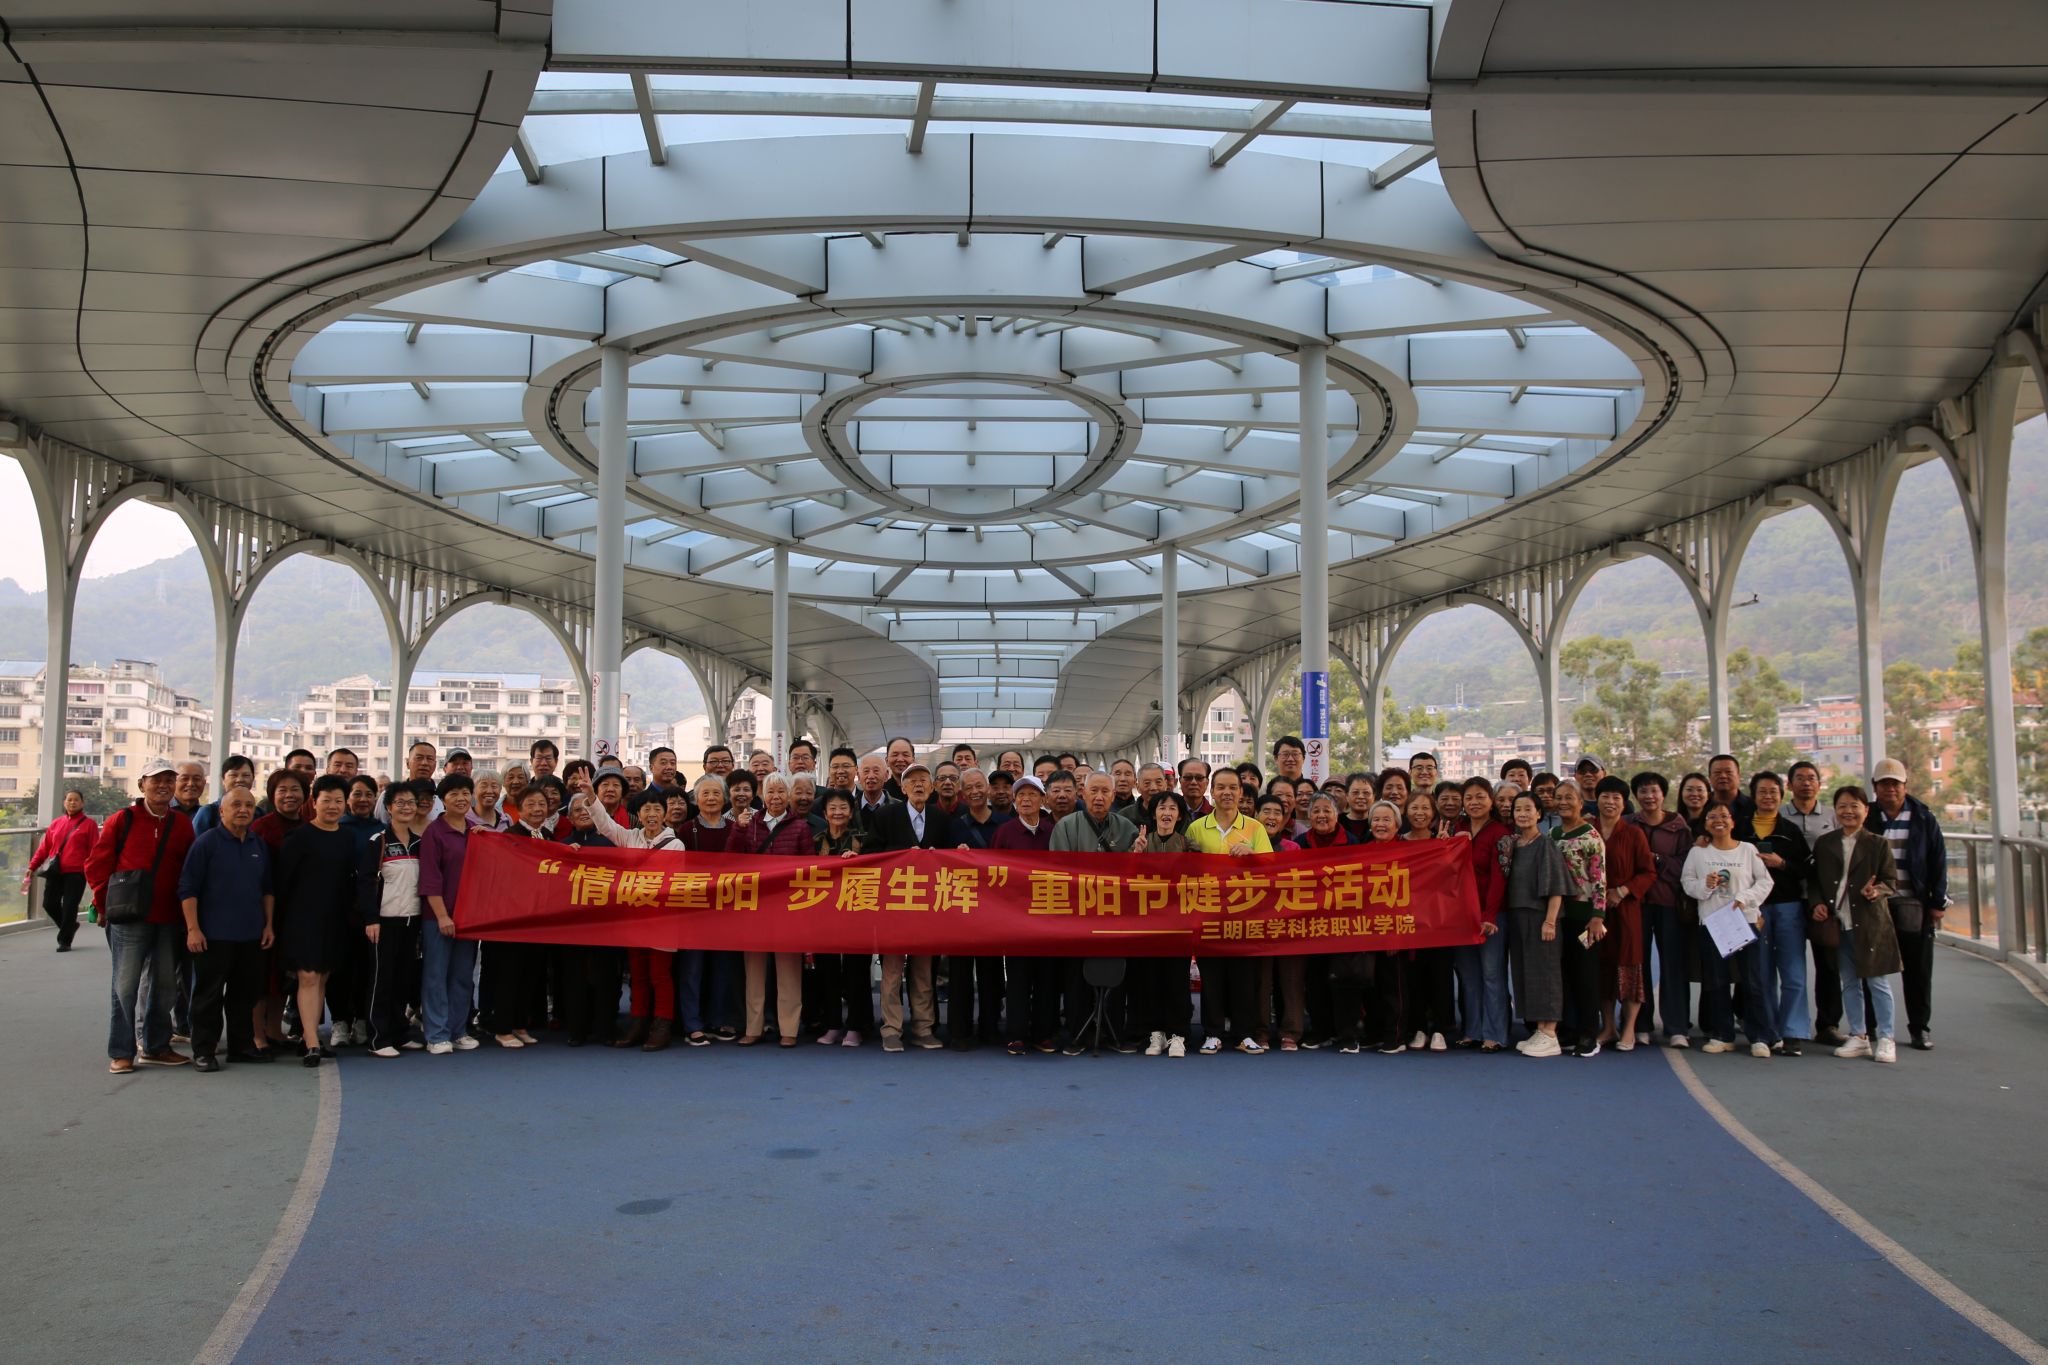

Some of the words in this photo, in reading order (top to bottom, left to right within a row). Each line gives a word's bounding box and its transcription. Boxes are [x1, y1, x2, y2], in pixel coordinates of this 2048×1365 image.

[1200, 914, 1416, 940] 三明医学科技职业学院
